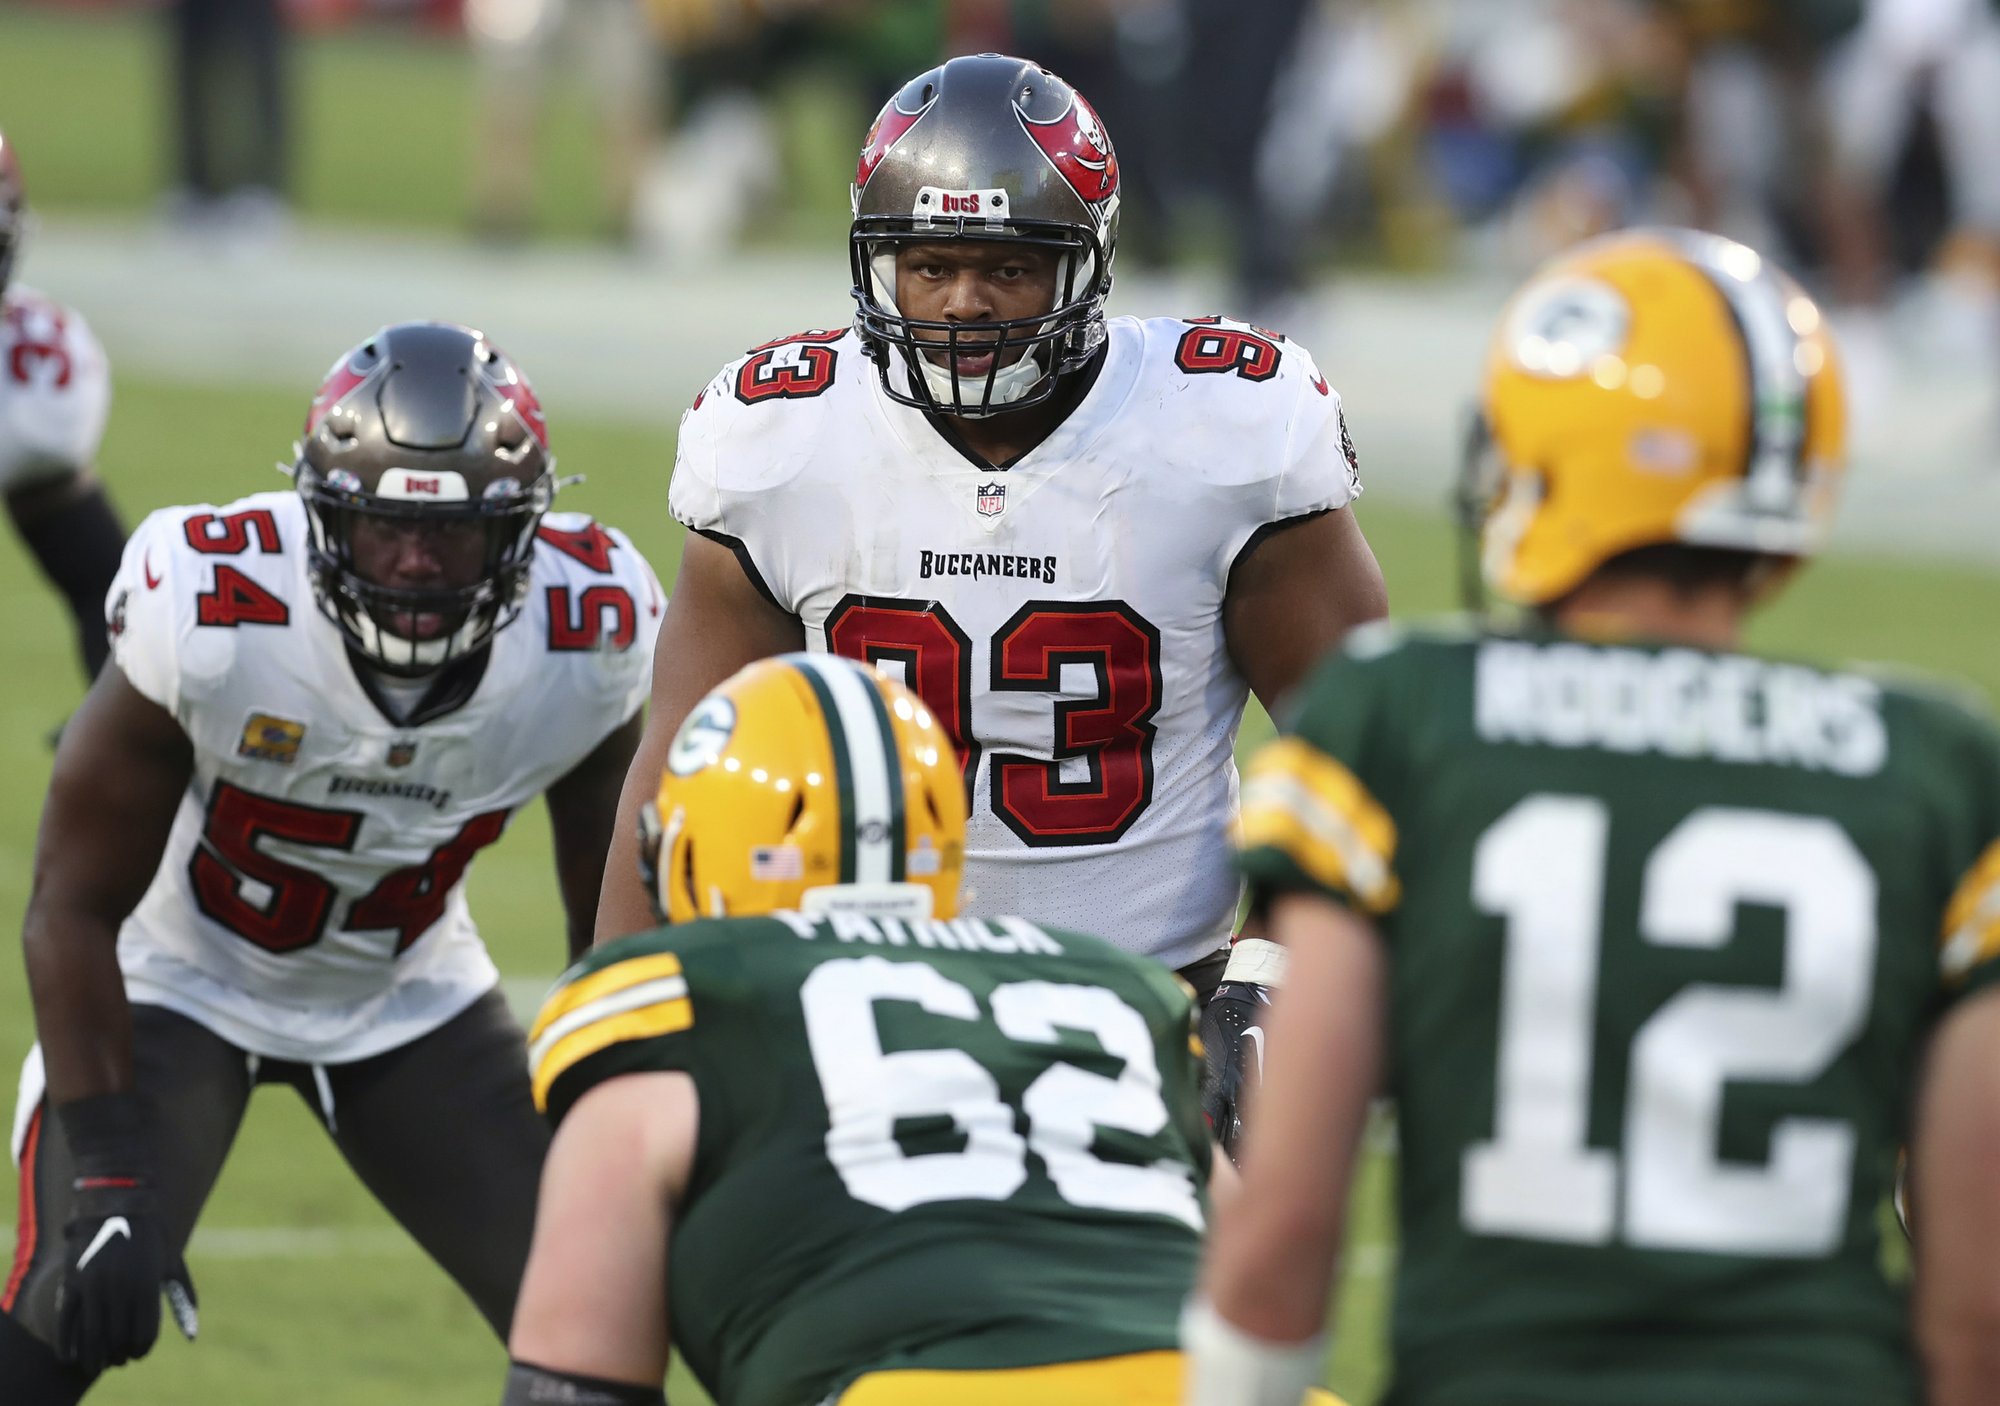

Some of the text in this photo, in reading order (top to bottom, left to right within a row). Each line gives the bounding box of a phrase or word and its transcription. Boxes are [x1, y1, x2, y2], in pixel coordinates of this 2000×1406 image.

[942, 193, 980, 214] BUCS
[1174, 316, 1285, 382] 9
[979, 495, 1002, 513] NFL
[183, 509, 290, 628] 54
[537, 521, 637, 653] 54
[920, 550, 1057, 584] BUCCANEERS
[189, 777, 514, 960] 54
[1460, 792, 1878, 1258] 12
[801, 954, 1207, 1233] 62
